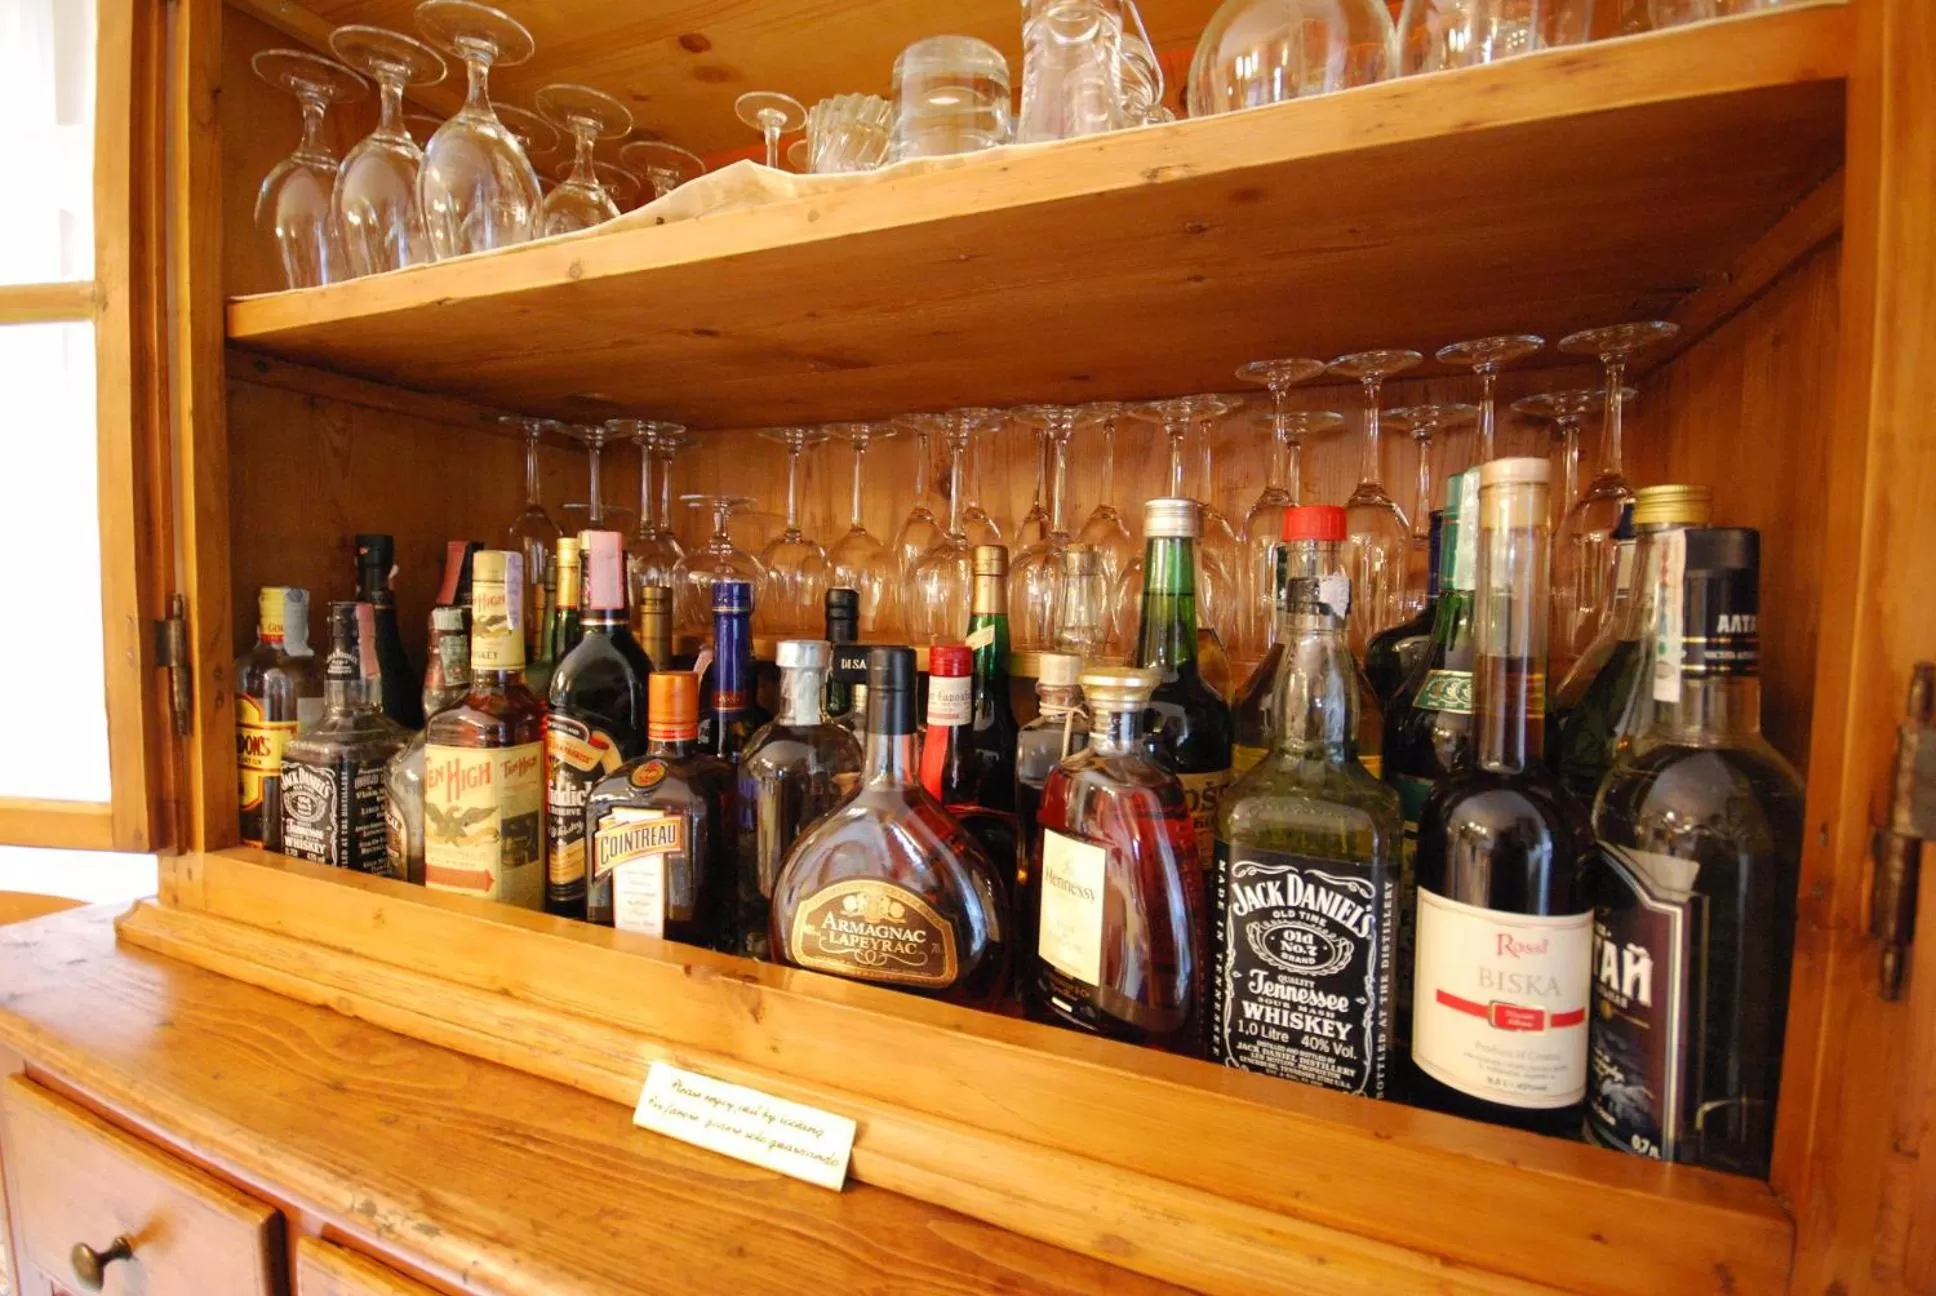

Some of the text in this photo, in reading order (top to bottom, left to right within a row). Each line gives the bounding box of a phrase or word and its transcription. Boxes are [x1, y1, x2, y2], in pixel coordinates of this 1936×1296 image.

[447, 758, 492, 802] HIGH
[600, 823, 676, 865] COINTREAU
[1045, 865, 1097, 904] Hennessy
[1231, 873, 1377, 939] JACK DANIEL'S
[1272, 909, 1328, 927] OLD TIME
[821, 911, 927, 943] ARMAGNAC
[829, 930, 918, 955] LAPEYRAC
[1282, 929, 1314, 945] Old
[1280, 940, 1318, 957] No.7
[1280, 952, 1316, 965] BRAND
[1248, 968, 1350, 1012] Tennessee
[1478, 966, 1563, 998] BISKA
[1242, 1000, 1353, 1041] WHISKEY
[1261, 1025, 1289, 1043] Litre
[1301, 1034, 1330, 1053] 40%
[1331, 1041, 1359, 1060] Vol.
[672, 1079, 702, 1098] Please
[762, 1108, 776, 1124] by
